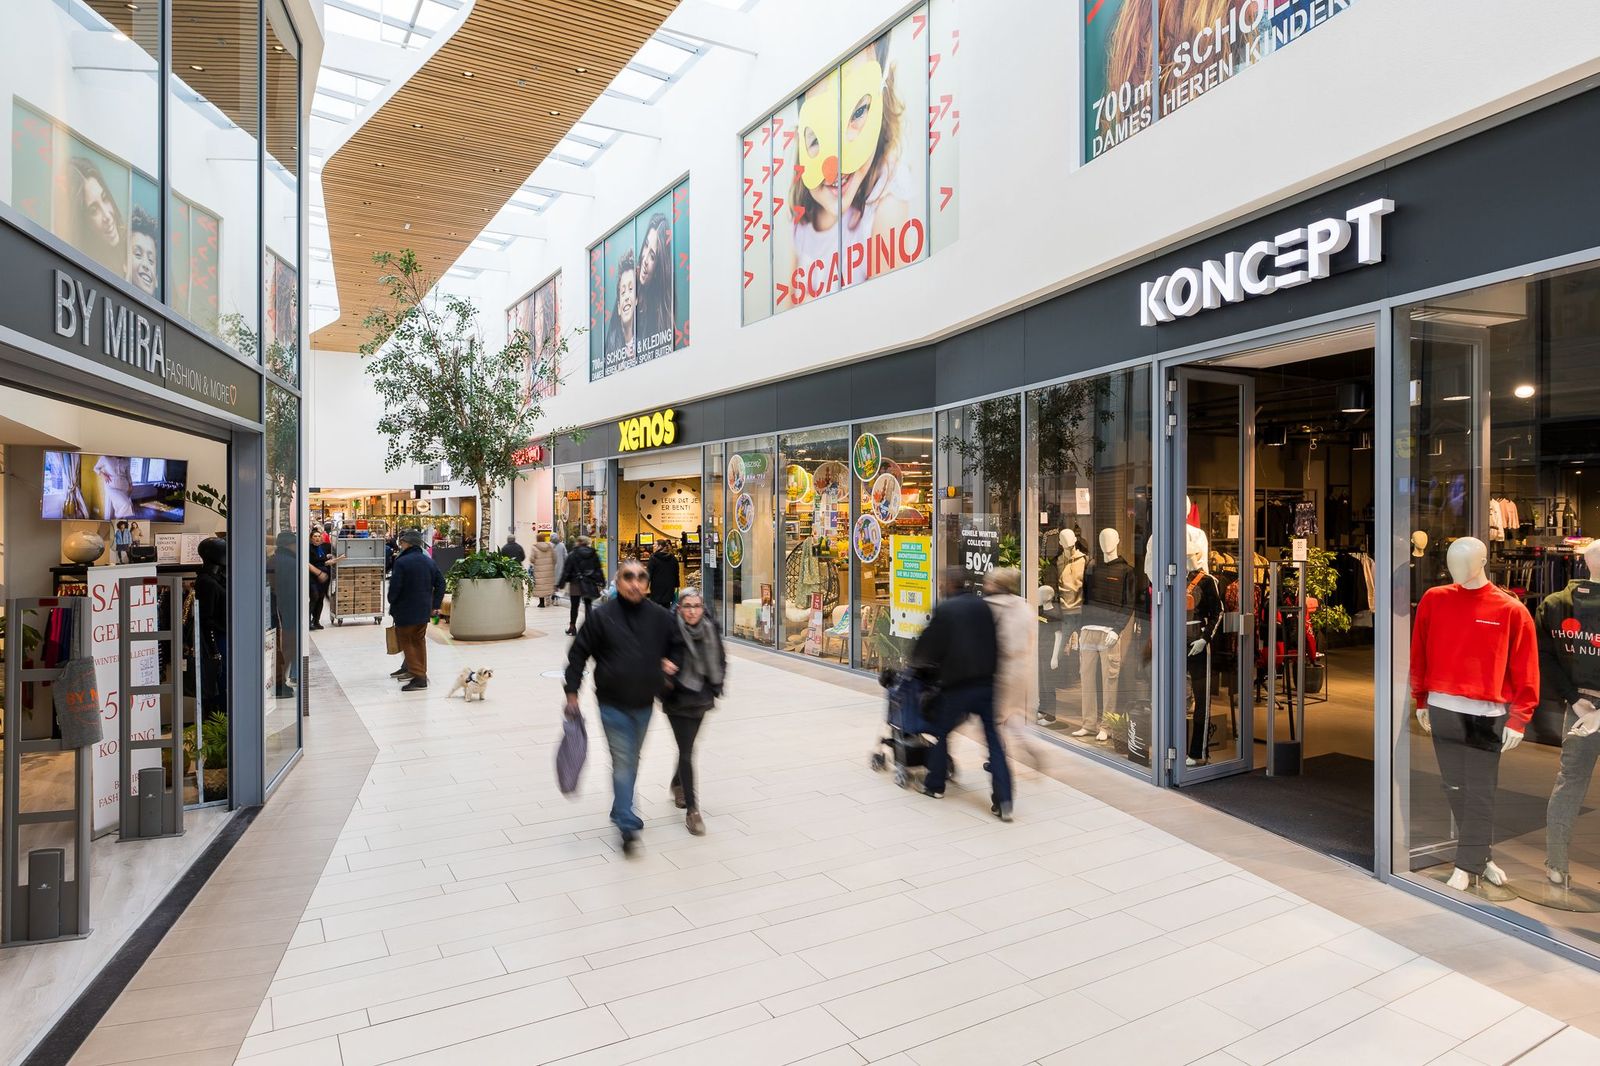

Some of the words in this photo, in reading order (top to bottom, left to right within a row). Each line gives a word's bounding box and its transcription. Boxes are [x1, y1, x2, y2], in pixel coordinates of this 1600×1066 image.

[1093, 105, 1152, 158] DAMES
[1163, 53, 1233, 115] HEREN
[1140, 198, 1395, 326] KONCEPT
[54, 268, 97, 347] BY
[103, 295, 166, 378] MIRA
[642, 328, 672, 352] KLEDING
[166, 358, 202, 393] FASHION
[203, 376, 209, 396] &
[211, 378, 230, 405] MORE
[618, 408, 675, 452] xenos
[961, 529, 978, 537] GEHELE
[979, 530, 998, 538] WINTER
[967, 540, 992, 548] COLLECTIE
[965, 551, 994, 573] 50%
[95, 654, 119, 666] WINTE
